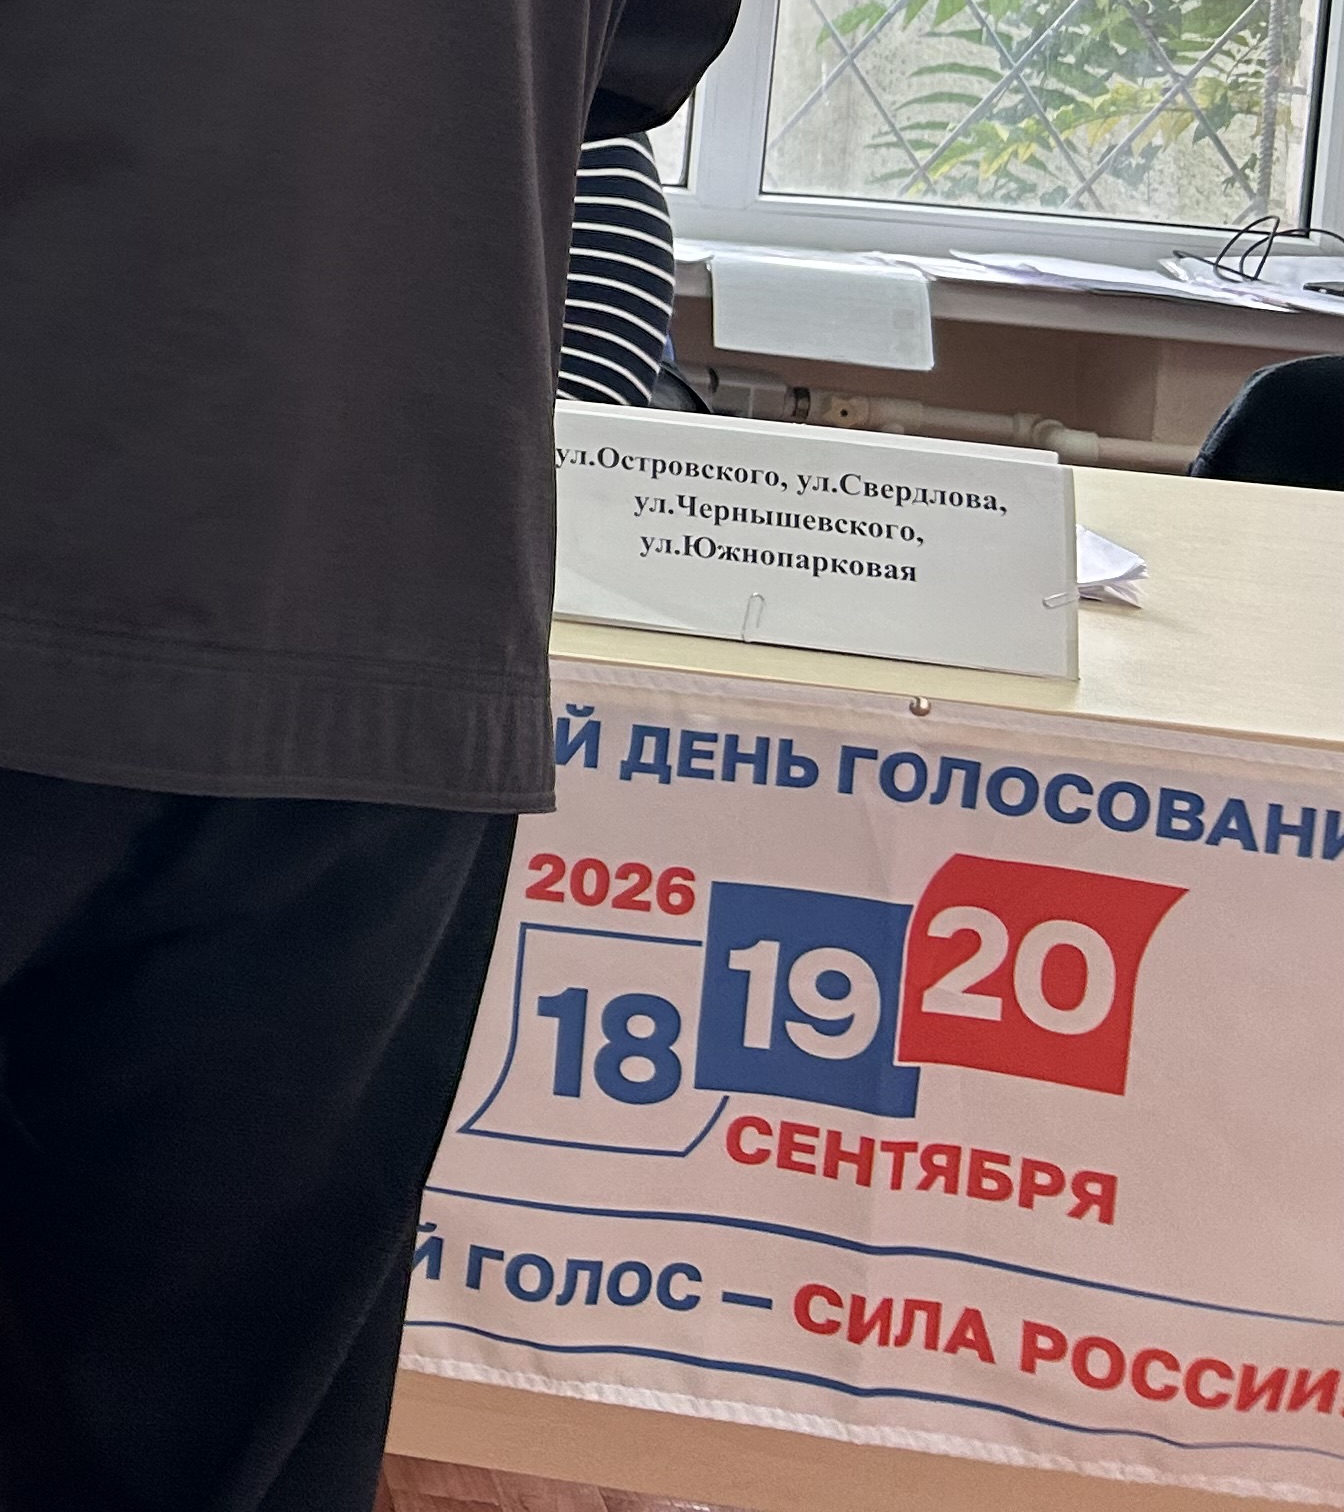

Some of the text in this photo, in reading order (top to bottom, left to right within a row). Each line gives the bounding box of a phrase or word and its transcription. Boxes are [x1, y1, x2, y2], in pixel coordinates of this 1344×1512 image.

[555, 446, 1008, 516] ул.Островского, ул.Свердлова,
[634, 492, 924, 547] ул.Чернышевского,
[639, 534, 918, 582] ул.Южнопарковая
[620, 720, 819, 789] ДЕНЬ
[524, 853, 697, 916] 2026
[728, 939, 882, 1059] 19
[921, 906, 1116, 1034] 20
[536, 987, 683, 1104] 18
[725, 1116, 1117, 1225] СЕНТЯБРЯ
[466, 1243, 703, 1311] ГОЛОС
[793, 1284, 996, 1365] СИЛА
[1021, 1321, 1344, 1418] РОССИИ
